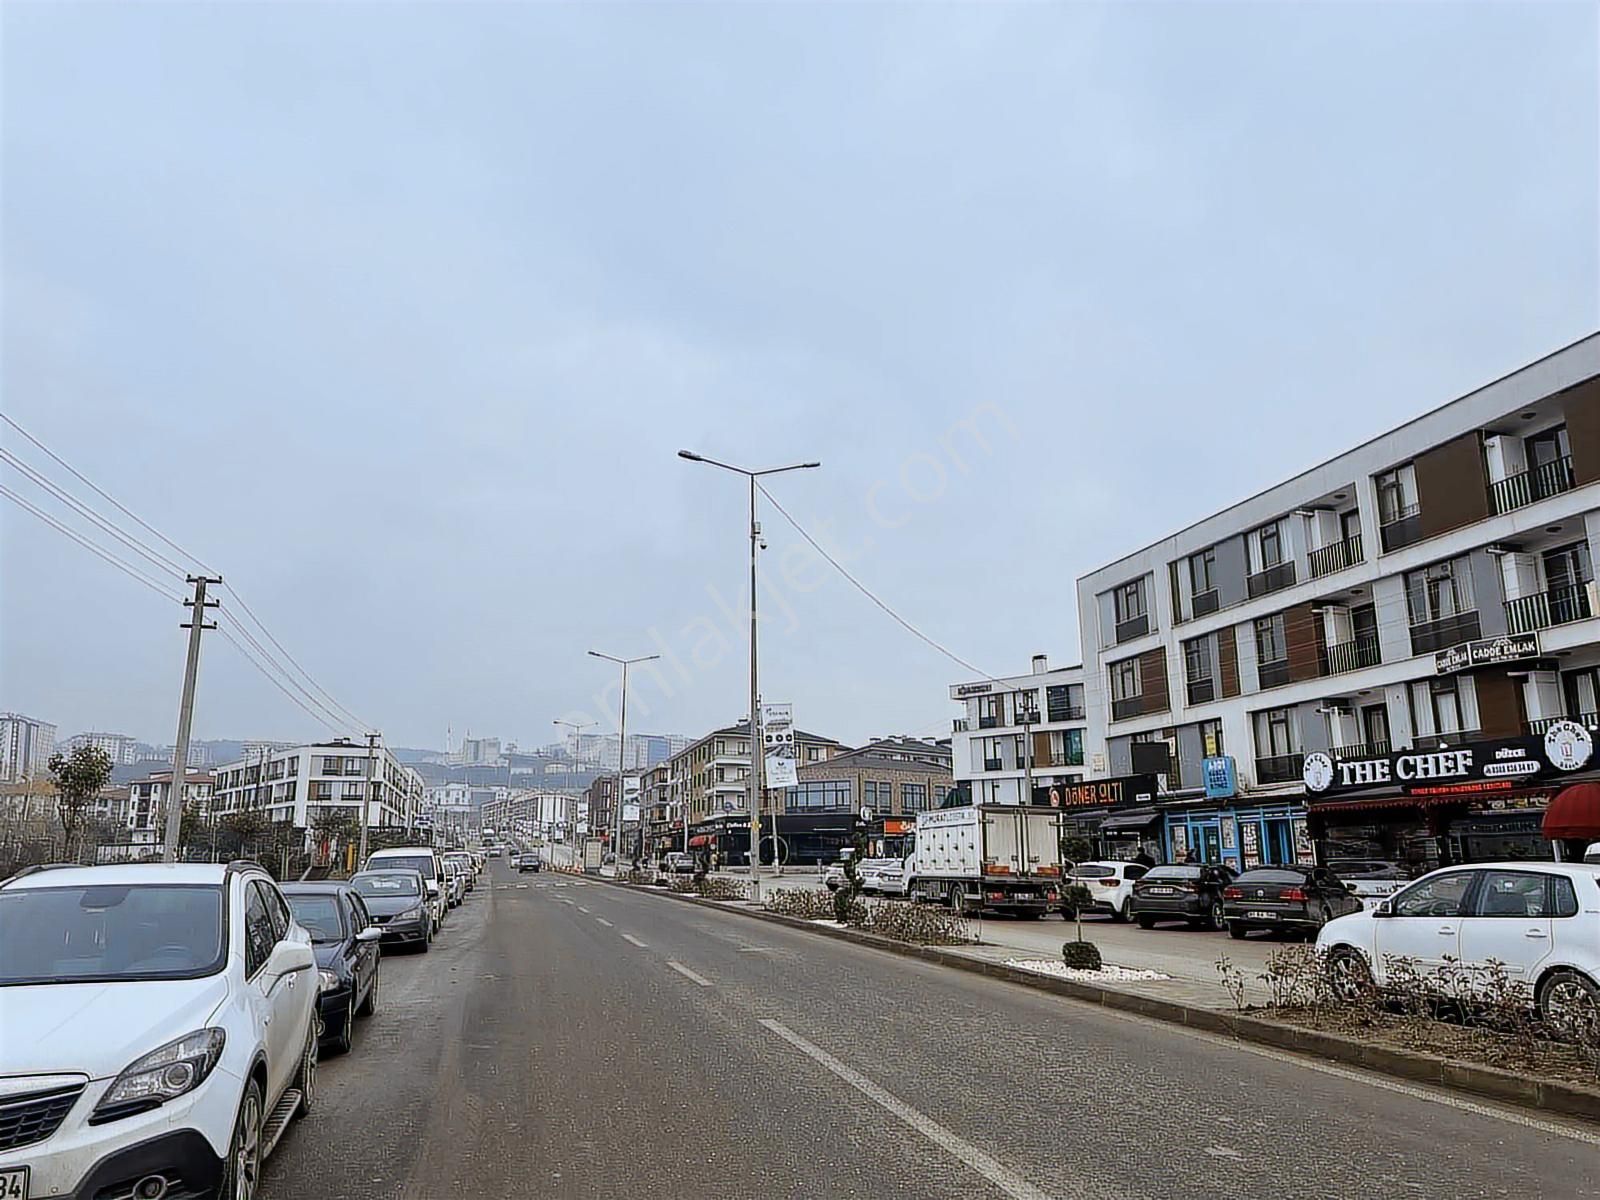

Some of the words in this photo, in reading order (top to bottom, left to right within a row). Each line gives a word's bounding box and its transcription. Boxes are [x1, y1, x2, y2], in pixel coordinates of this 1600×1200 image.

[1503, 641, 1535, 655] EMLAK
[1338, 759, 1391, 786] THE
[1396, 750, 1473, 780] CHEF
